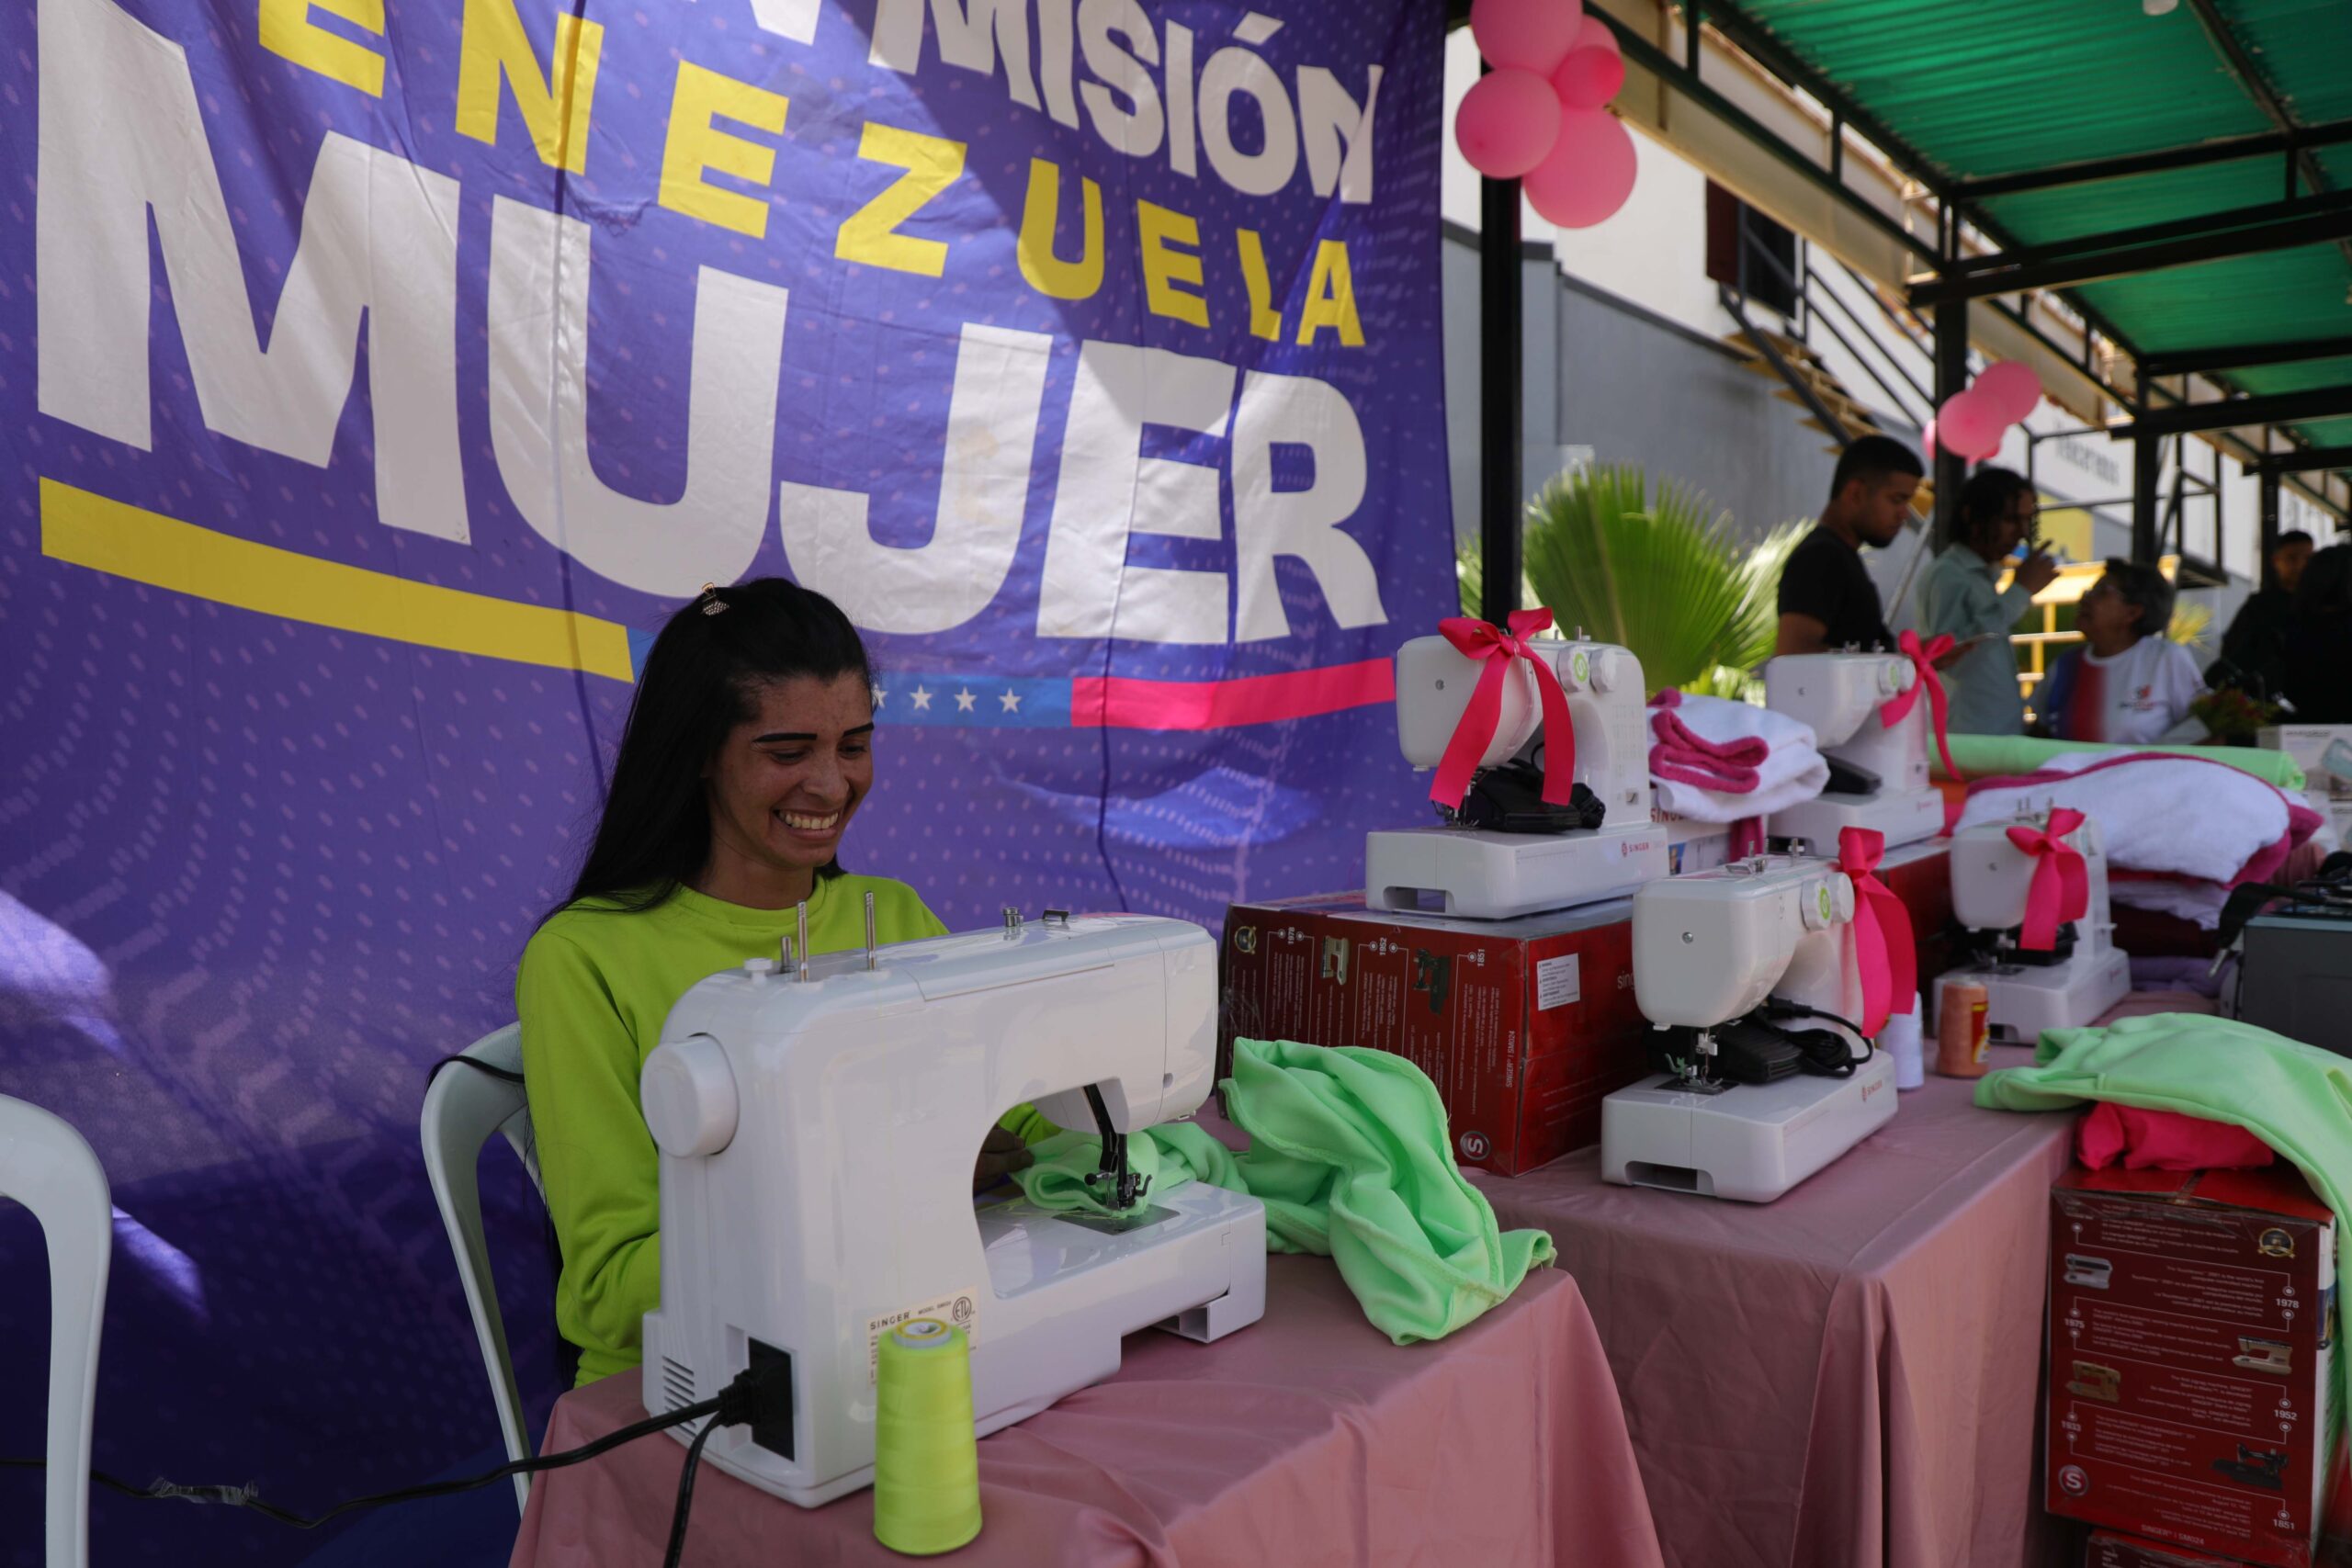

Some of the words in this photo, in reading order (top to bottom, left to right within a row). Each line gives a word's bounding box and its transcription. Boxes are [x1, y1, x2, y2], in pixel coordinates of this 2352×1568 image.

[868, 0, 1384, 204] MISIÓN
[37, 0, 1388, 645] MUJER
[2276, 1298, 2300, 1309] 1978
[869, 1311, 910, 1330] SINGER
[2274, 1409, 2298, 1421] 1952
[2066, 1472, 2082, 1489] S
[2272, 1518, 2295, 1530] 1851
